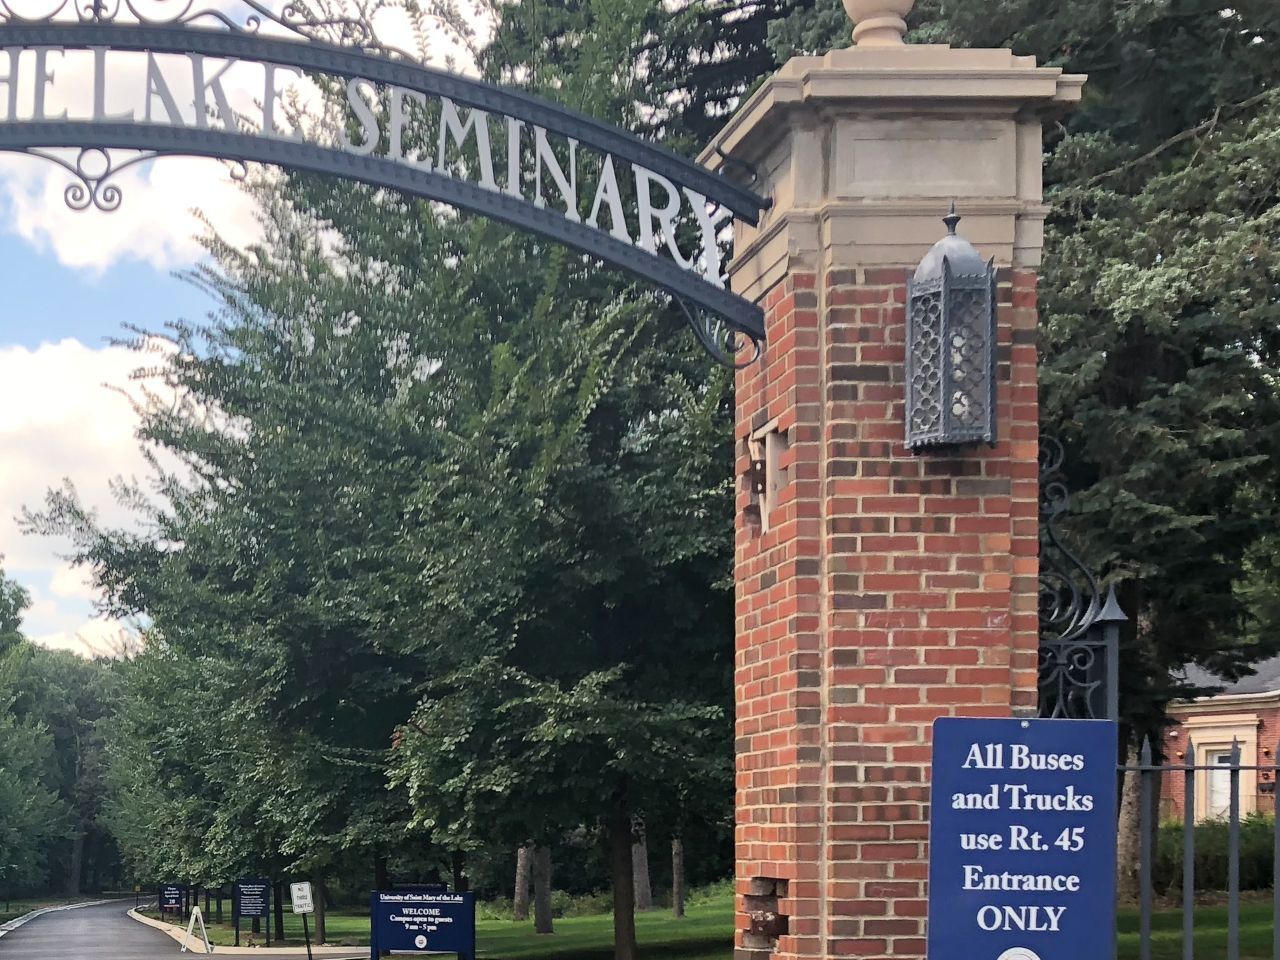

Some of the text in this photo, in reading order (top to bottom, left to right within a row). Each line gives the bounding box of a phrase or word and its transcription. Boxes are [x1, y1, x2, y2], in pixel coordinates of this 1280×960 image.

[86, 45, 302, 140] LAKE
[338, 76, 734, 290] SEMINARY
[961, 743, 1085, 770] All Buses
[951, 784, 1094, 811] and Trucks
[960, 825, 1085, 852] use Rt. 45
[962, 865, 1080, 891] Entrance
[380, 893, 403, 901] University
[423, 894, 436, 902] Mary
[390, 914, 412, 923] Campus
[435, 917, 452, 925] guests
[976, 905, 1066, 931] ONLY
